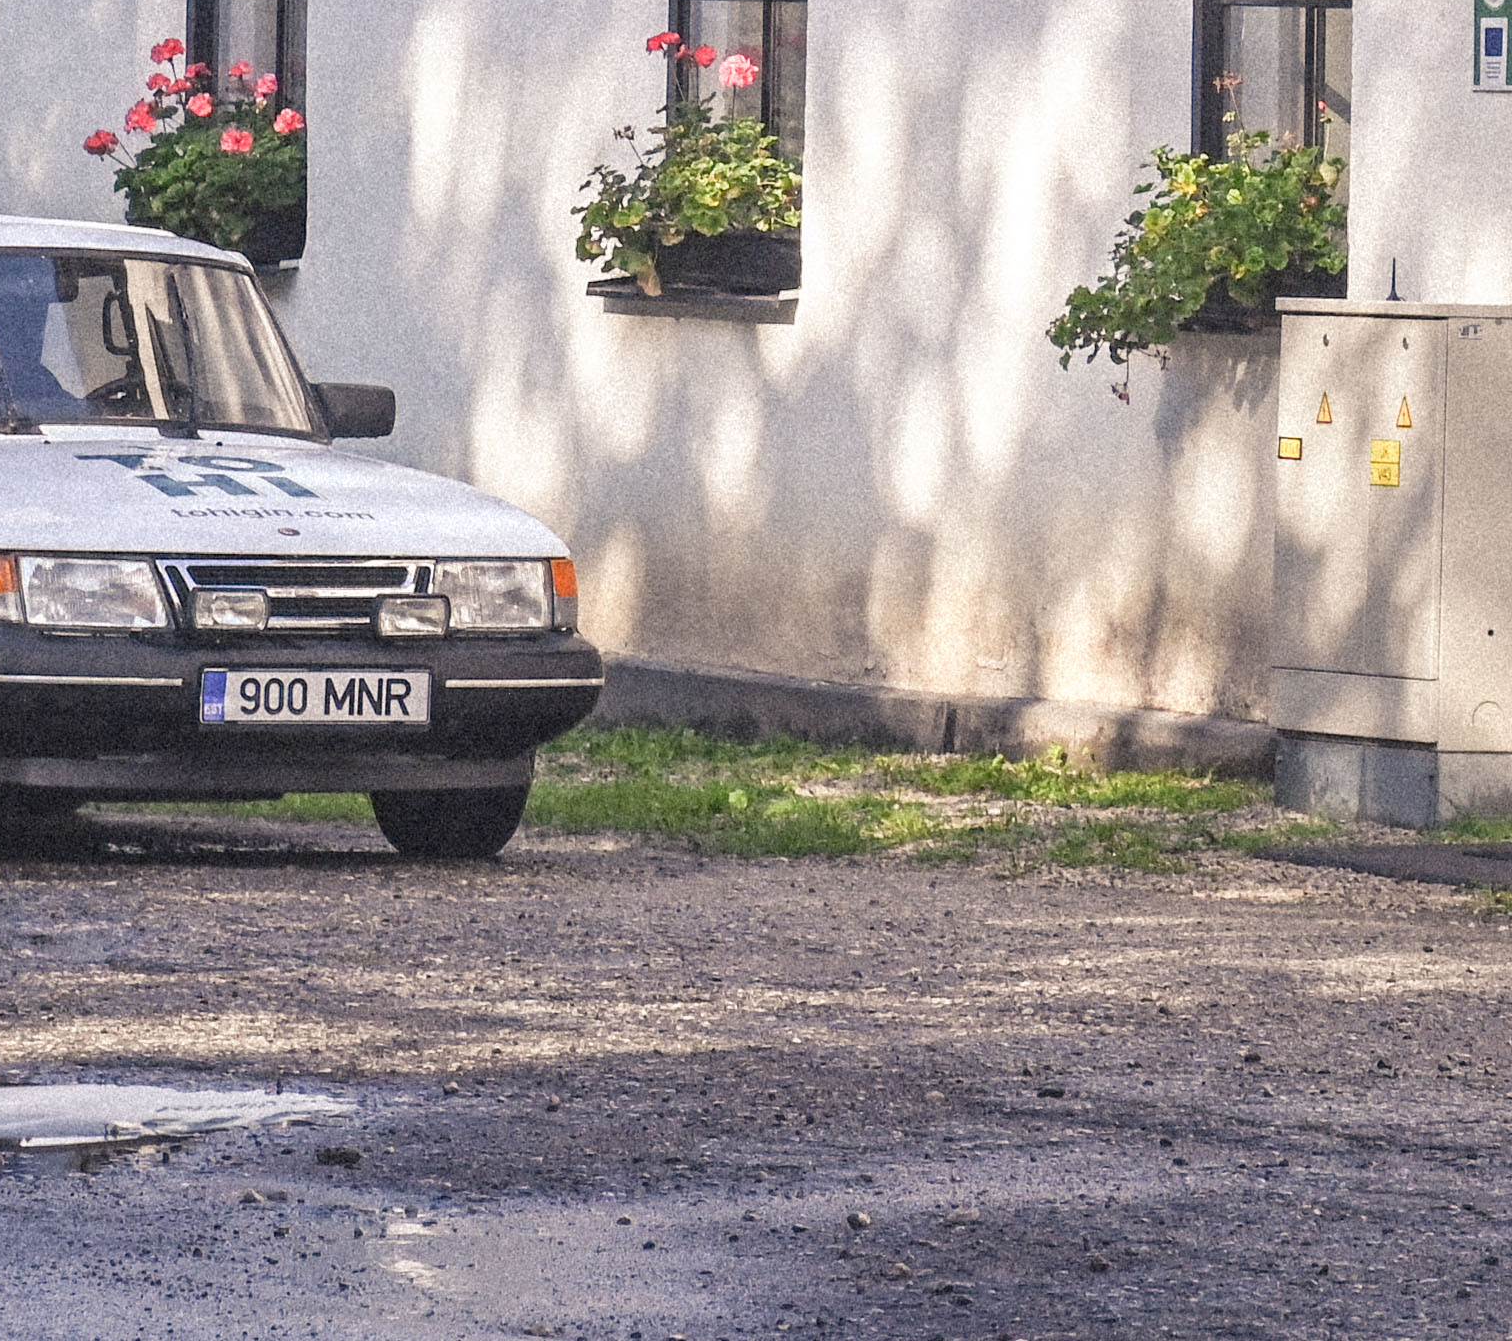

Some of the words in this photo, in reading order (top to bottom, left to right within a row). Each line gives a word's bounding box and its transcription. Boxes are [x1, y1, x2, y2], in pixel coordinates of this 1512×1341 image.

[170, 507, 377, 521] tohigin.com
[240, 677, 308, 716] 900
[323, 677, 413, 716] MNR
[204, 703, 224, 715] EST
